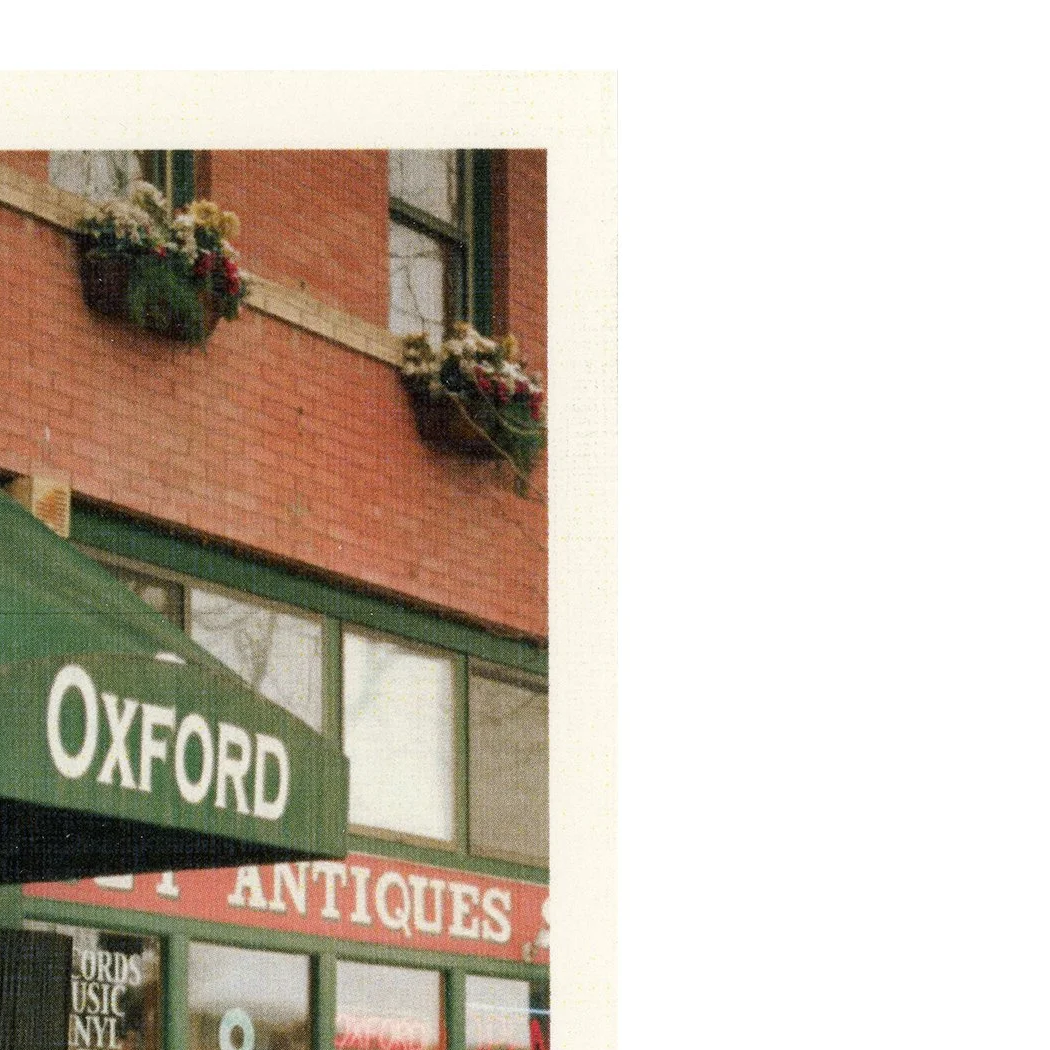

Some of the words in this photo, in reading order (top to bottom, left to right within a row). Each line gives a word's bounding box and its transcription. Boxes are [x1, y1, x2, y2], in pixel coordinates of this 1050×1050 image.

[47, 663, 290, 821] OXFORD
[227, 861, 513, 945] ANTIQUES
[71, 951, 142, 987] ORDS
[71, 981, 126, 1018] USIC
[70, 1014, 121, 1049] NYL
